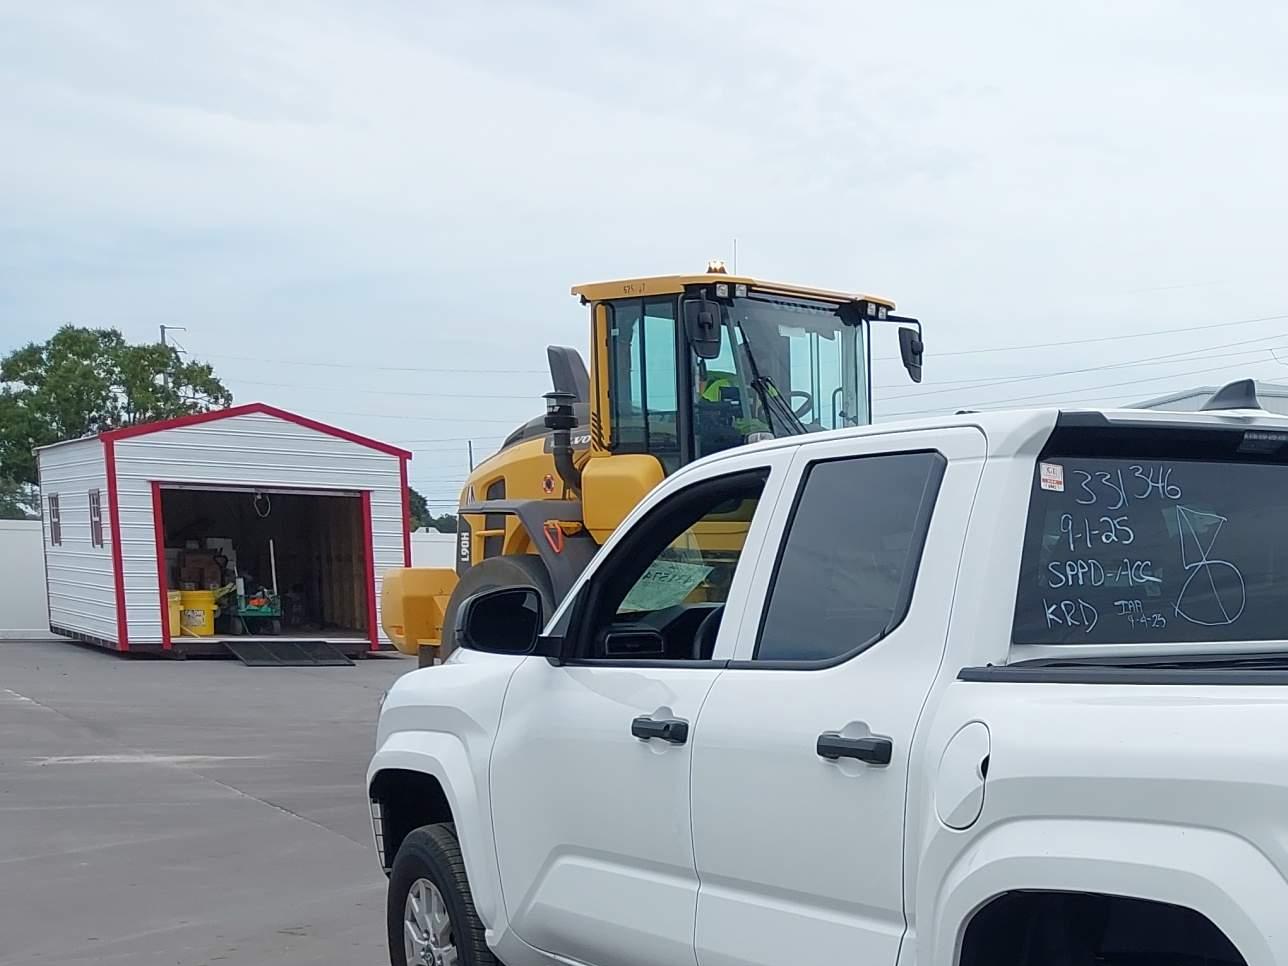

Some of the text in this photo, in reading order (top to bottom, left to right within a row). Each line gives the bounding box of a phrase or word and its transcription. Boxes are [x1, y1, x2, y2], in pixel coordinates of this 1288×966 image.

[1073, 465, 1182, 510] 331346
[460, 531, 470, 562] L90H
[1060, 513, 1134, 551] 9-1-25
[1043, 598, 1098, 633] KRD
